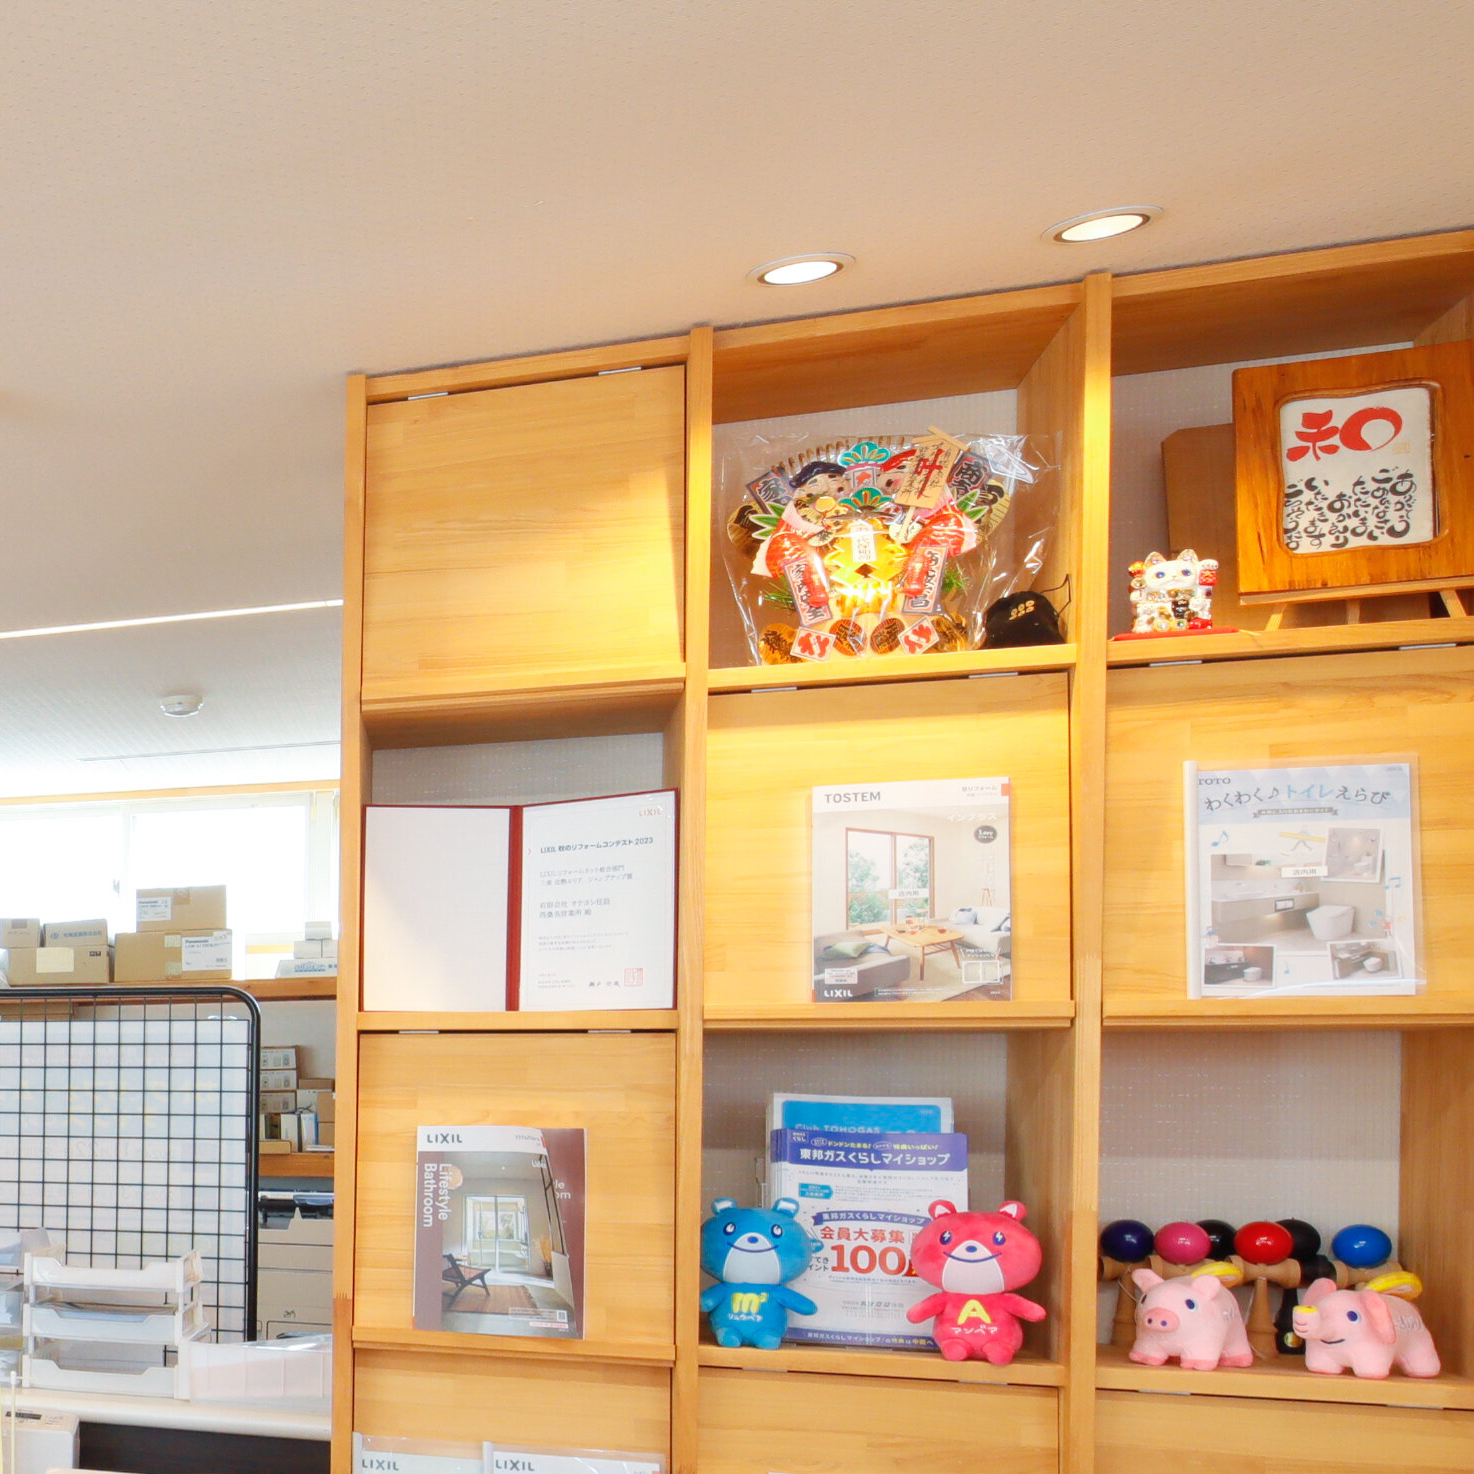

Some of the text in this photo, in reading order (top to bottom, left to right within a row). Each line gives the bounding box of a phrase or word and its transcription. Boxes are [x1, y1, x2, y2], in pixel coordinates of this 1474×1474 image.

[1286, 406, 1403, 462] 和
[824, 791, 882, 804] TOSTEM
[634, 836, 654, 846] 2023
[823, 988, 854, 998] LIXIL
[427, 1133, 463, 1144] LIXIL
[799, 1147, 951, 1167] 東邦ガスくらしマイショップ
[423, 1163, 438, 1228] Bathroom
[438, 1163, 453, 1221] Lifestyle
[820, 1226, 905, 1244] 会員大募集
[362, 1459, 400, 1472] LIXIL
[495, 1458, 536, 1473] LIXIL
